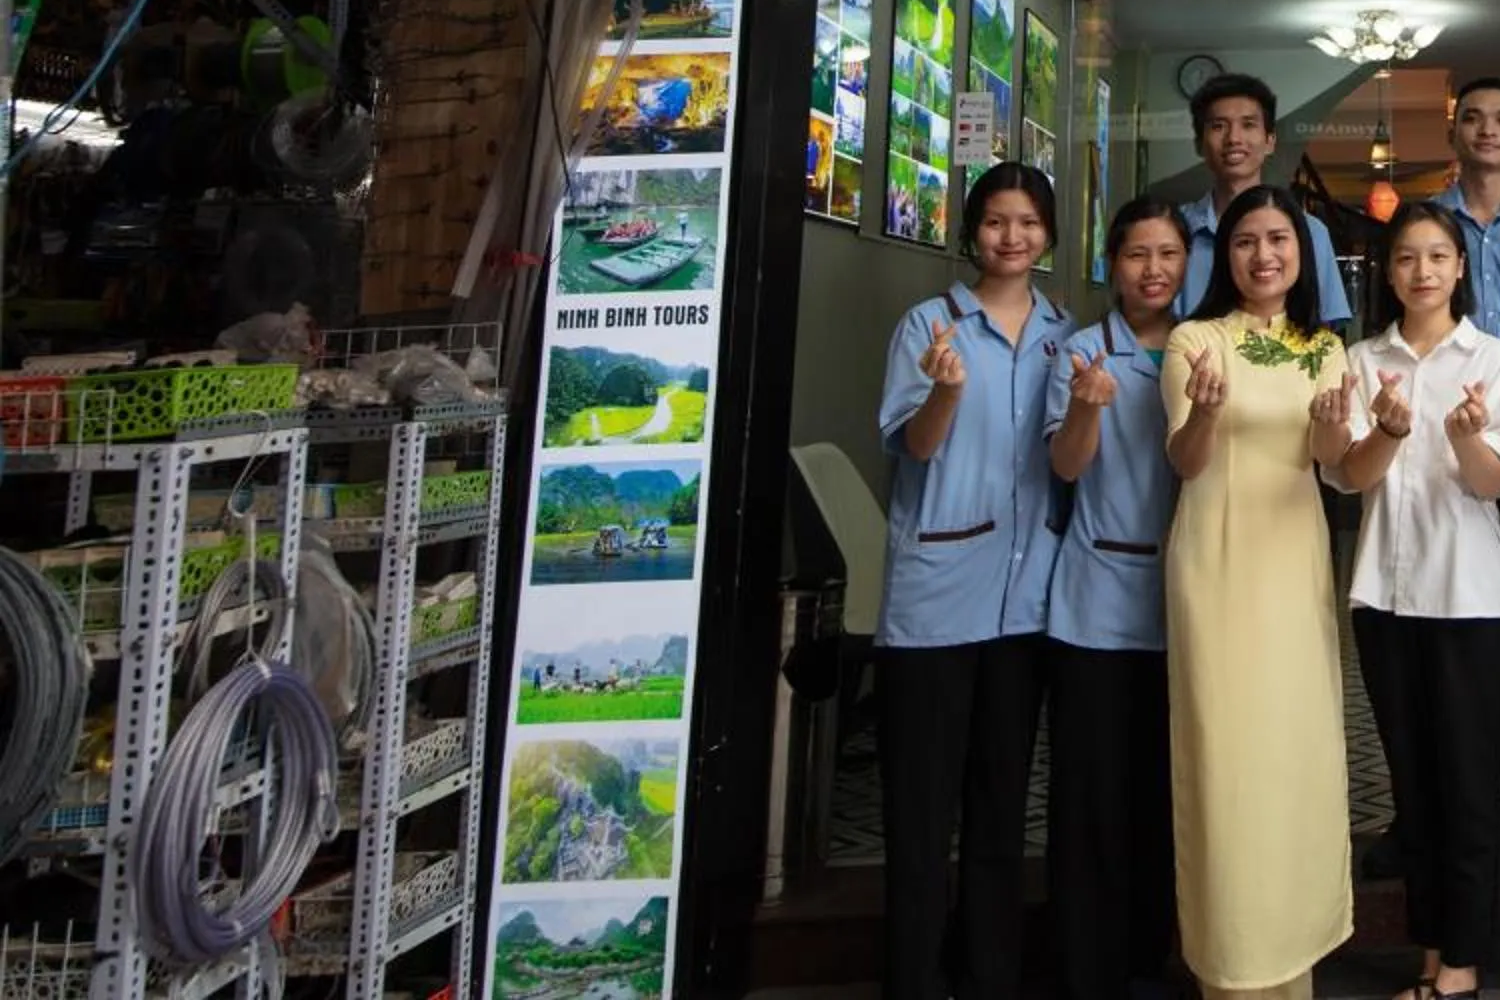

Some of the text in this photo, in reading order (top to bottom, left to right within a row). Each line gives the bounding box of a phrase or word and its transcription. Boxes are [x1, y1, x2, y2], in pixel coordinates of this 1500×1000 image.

[556, 304, 710, 331] NINH BINH TOURS
